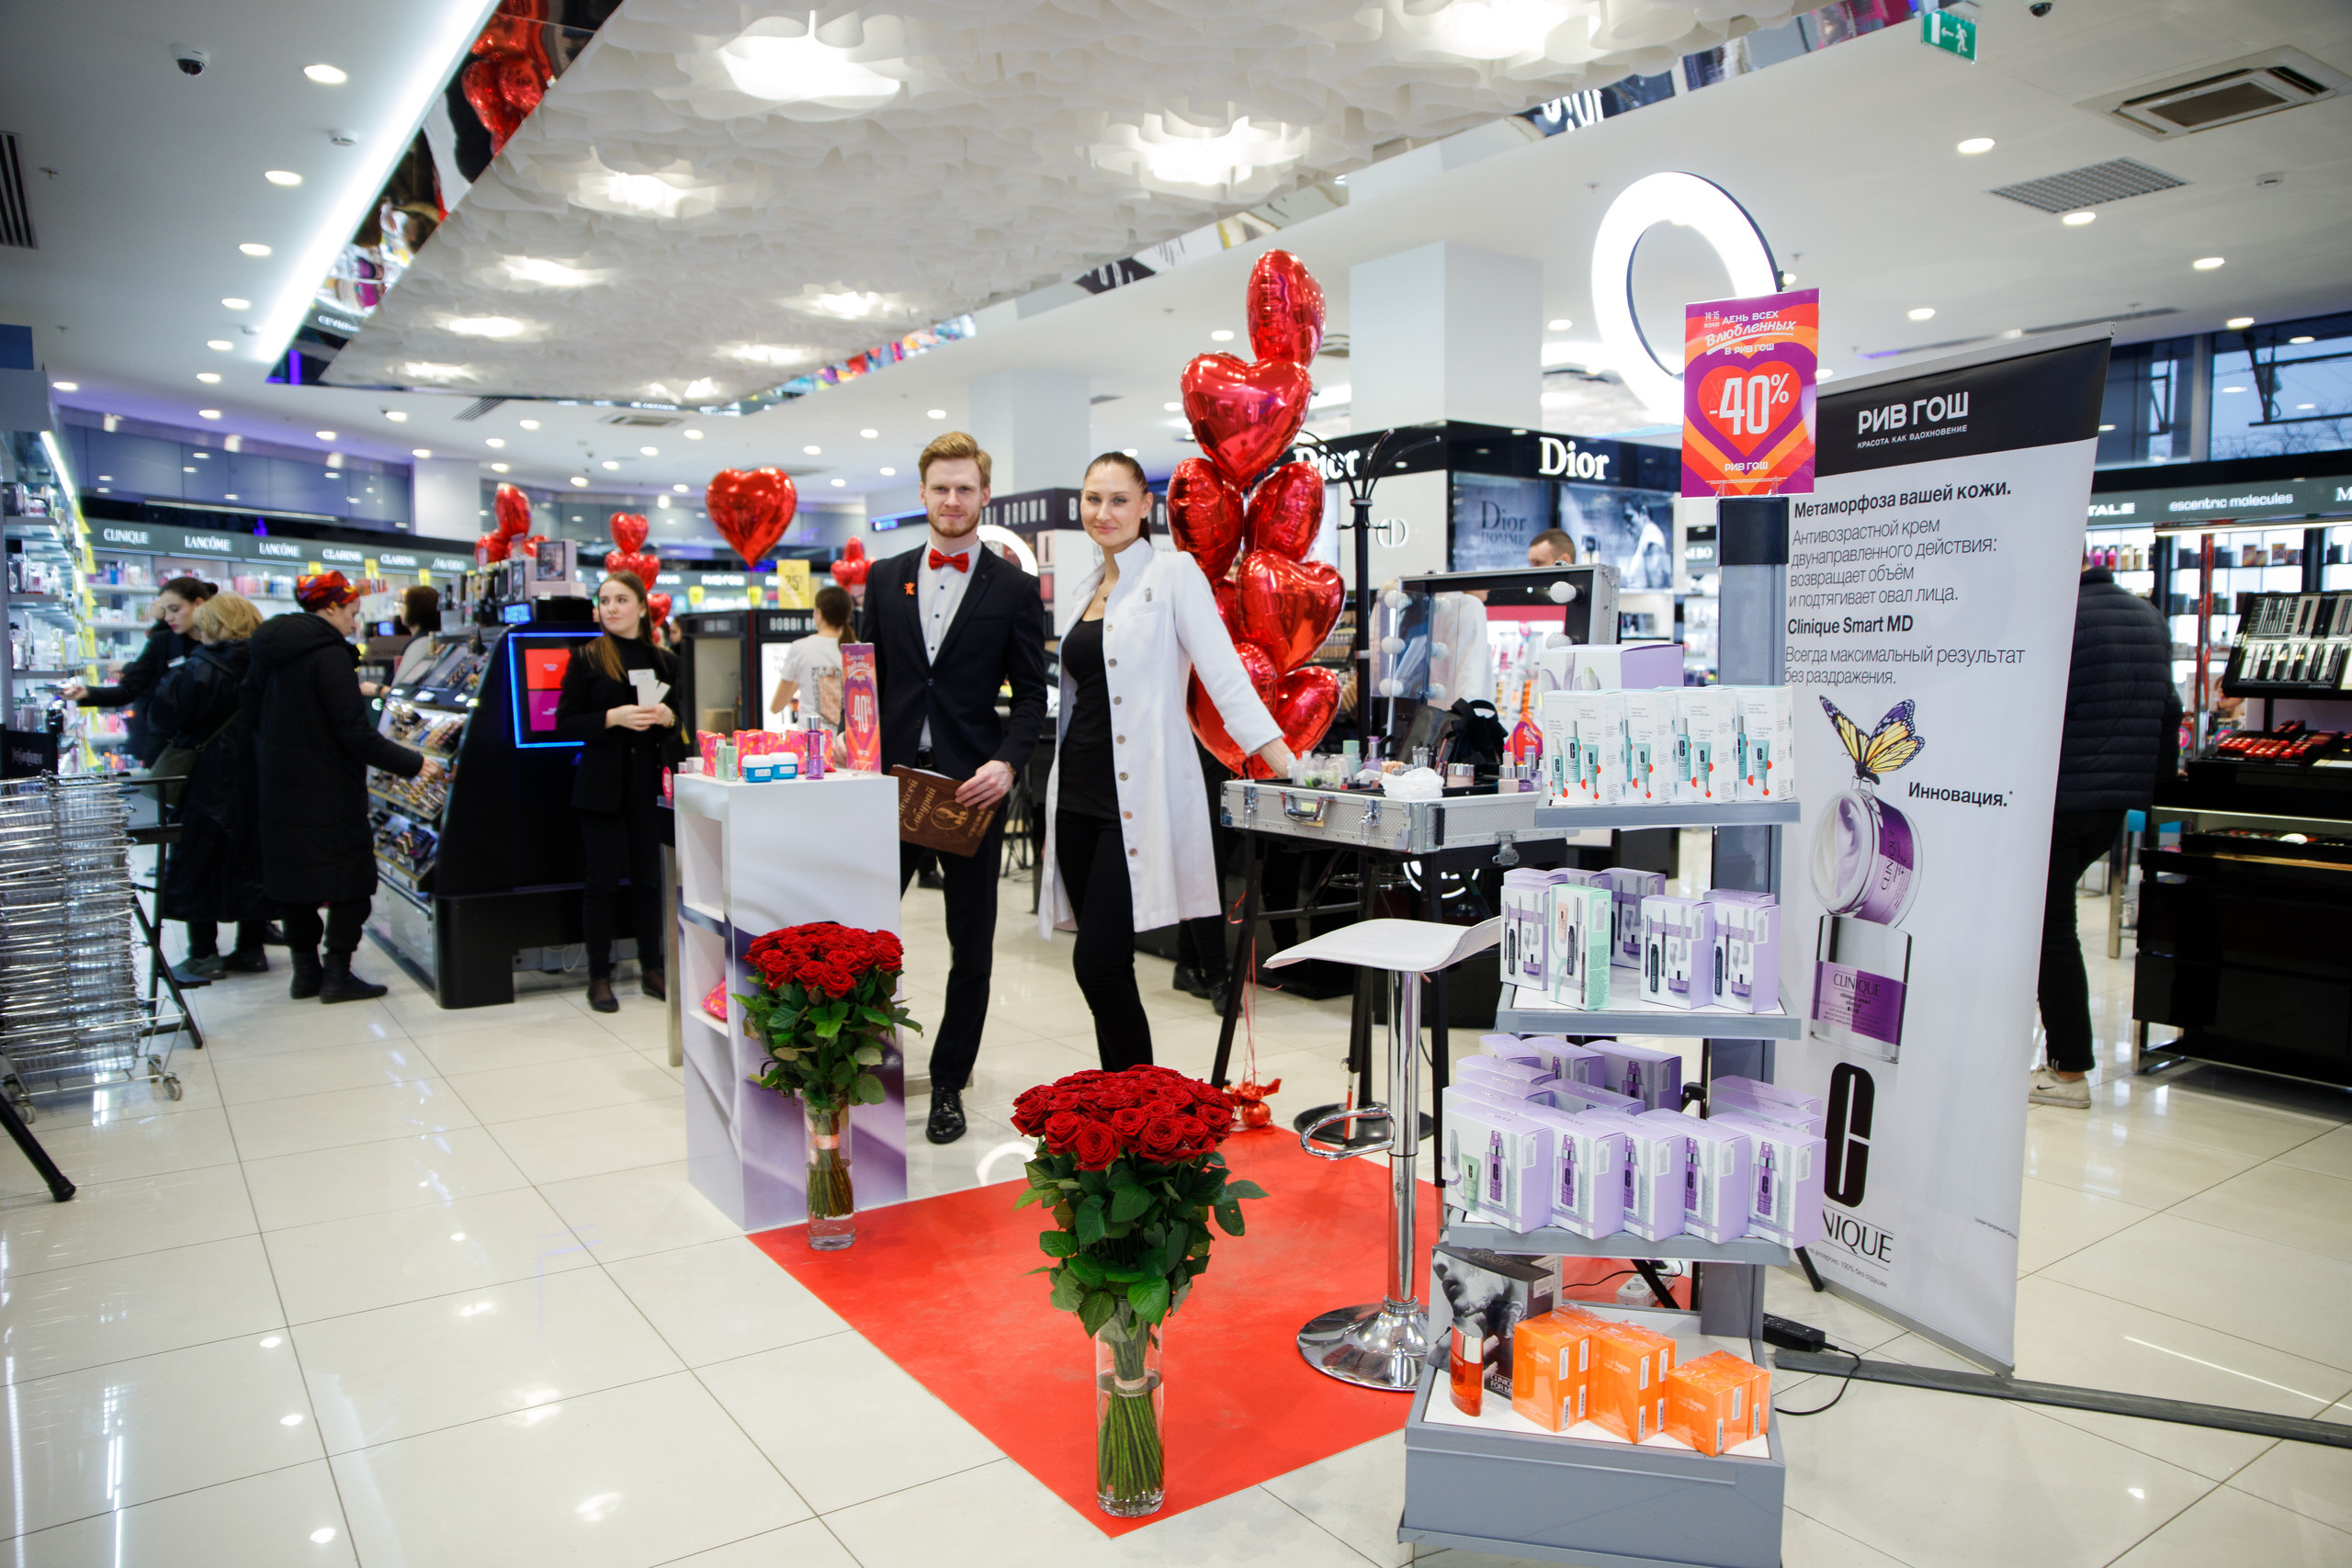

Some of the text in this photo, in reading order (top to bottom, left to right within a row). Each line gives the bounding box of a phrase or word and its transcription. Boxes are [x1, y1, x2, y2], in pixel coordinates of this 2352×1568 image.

[1722, 310, 1779, 325] ДЕНЬ ВСЕХ
[1704, 321, 1797, 347] Влюбленных
[1724, 343, 1775, 355] В РИВ ГОШ
[1709, 373, 1790, 435] -40%
[1858, 391, 1969, 435] РИВ ГОШ
[1857, 424, 1968, 449] КРАСОТА КАК ВДОХНОВЕНИЕ
[1538, 436, 1610, 480] Dior
[1724, 461, 1769, 471] РИВ ГОШ
[1794, 480, 2012, 519] Метаморфоза вашей кожи.
[2087, 502, 2135, 517] TALE
[2229, 492, 2294, 508] molecules
[1480, 501, 1527, 531] Dior
[103, 528, 149, 546] CLINIQUE
[1481, 531, 1526, 546] HOMME
[1792, 518, 1940, 547] Антивозрастной крем
[185, 535, 232, 552] LANCÔME
[259, 542, 300, 558] LANCÔME
[1791, 537, 1998, 570] двунаправленного действия:
[322, 548, 364, 562] CLARINS
[379, 553, 416, 567] CLARINS
[1790, 562, 1915, 590] возвращает объём
[1789, 586, 1959, 610] и подтягивает овал лица.
[769, 617, 801, 631] BOBBI
[1787, 615, 1914, 637] Clinique Smart MD
[1785, 645, 2027, 668] Всегда максимальный результат
[1784, 666, 1897, 687] без раздражения.
[1833, 973, 1882, 997] CLINIQUE
[1822, 1209, 1894, 1264] NIQUE
[1490, 1373, 1513, 1389] CLINIQ
[1490, 1380, 1504, 1393] FOR
